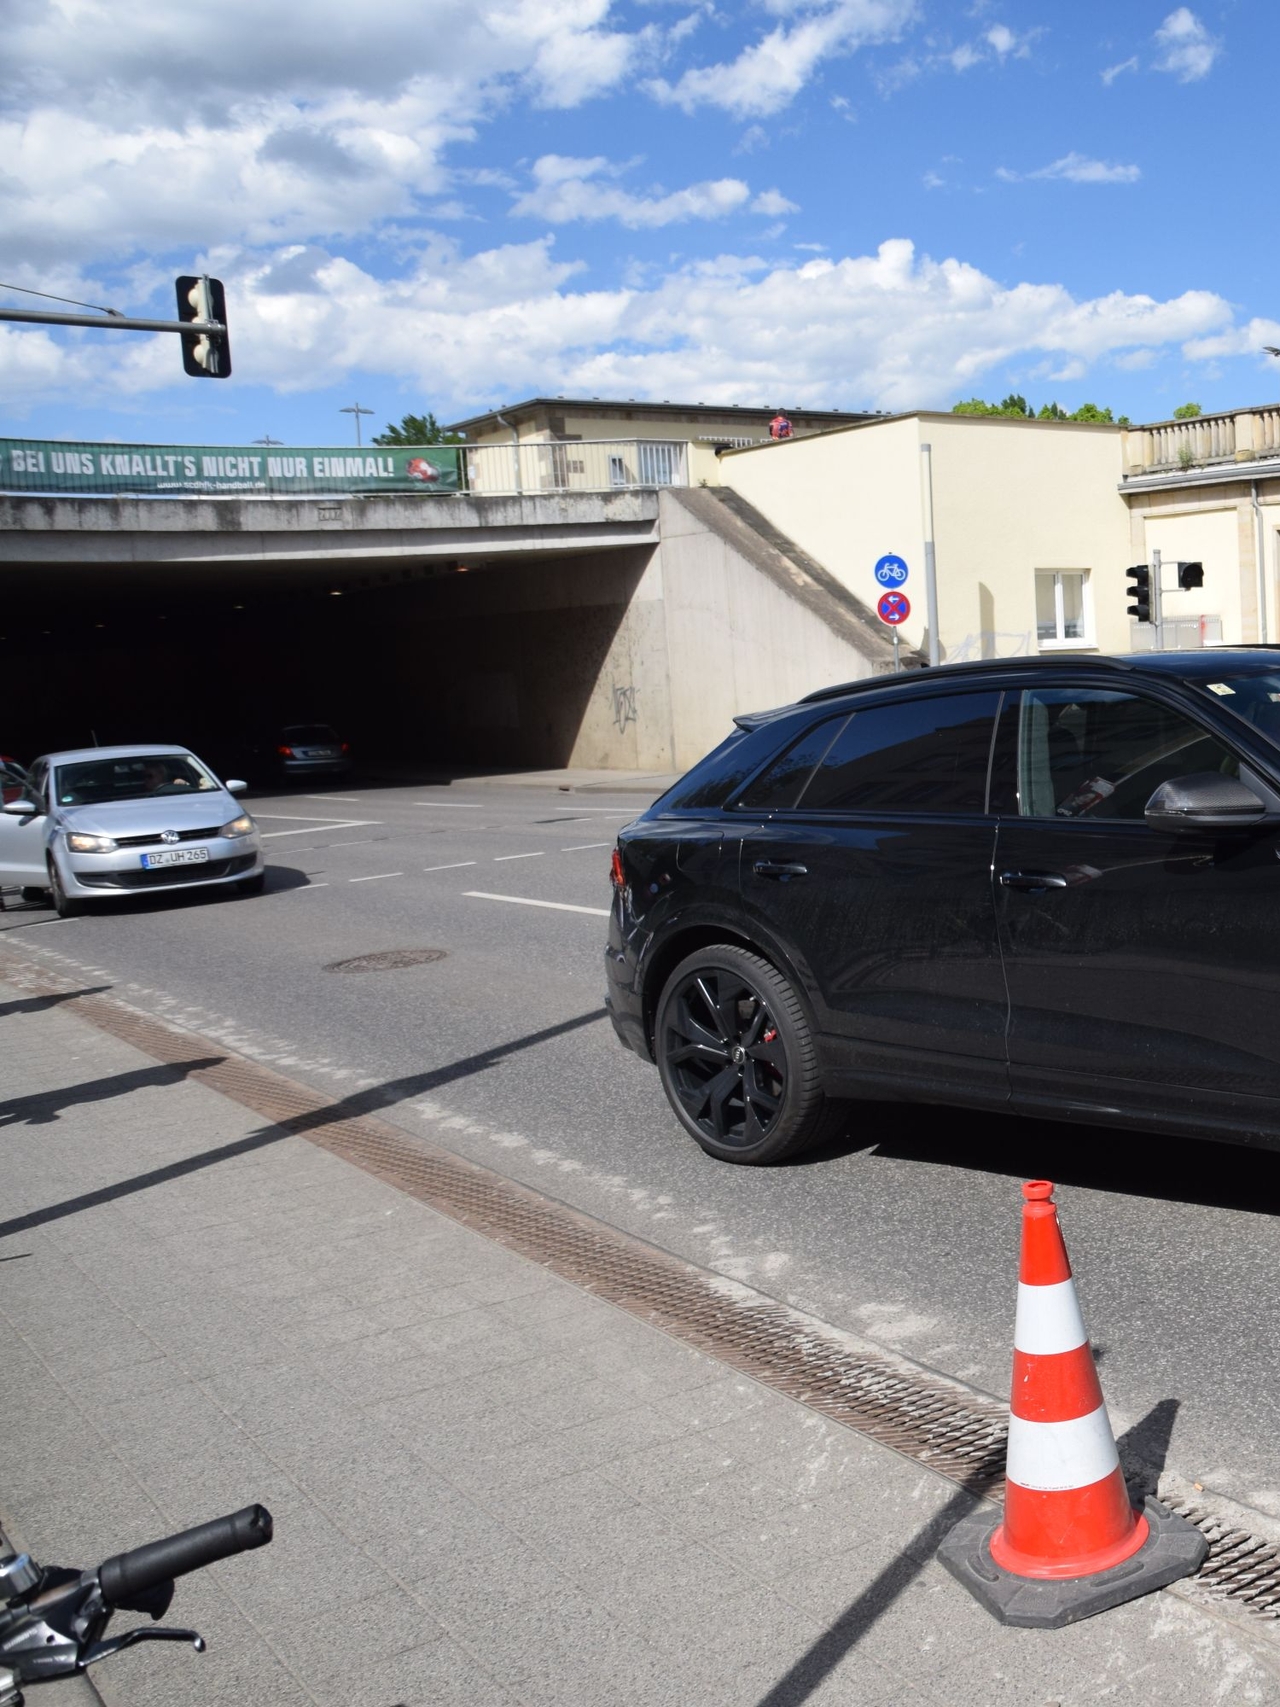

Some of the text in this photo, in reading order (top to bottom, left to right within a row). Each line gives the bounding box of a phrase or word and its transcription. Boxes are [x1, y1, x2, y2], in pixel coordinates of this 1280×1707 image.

[11, 449, 395, 478] BEI UNS KNALLT'S NICHT NUR EINMAL!
[149, 854, 163, 865] DZ
